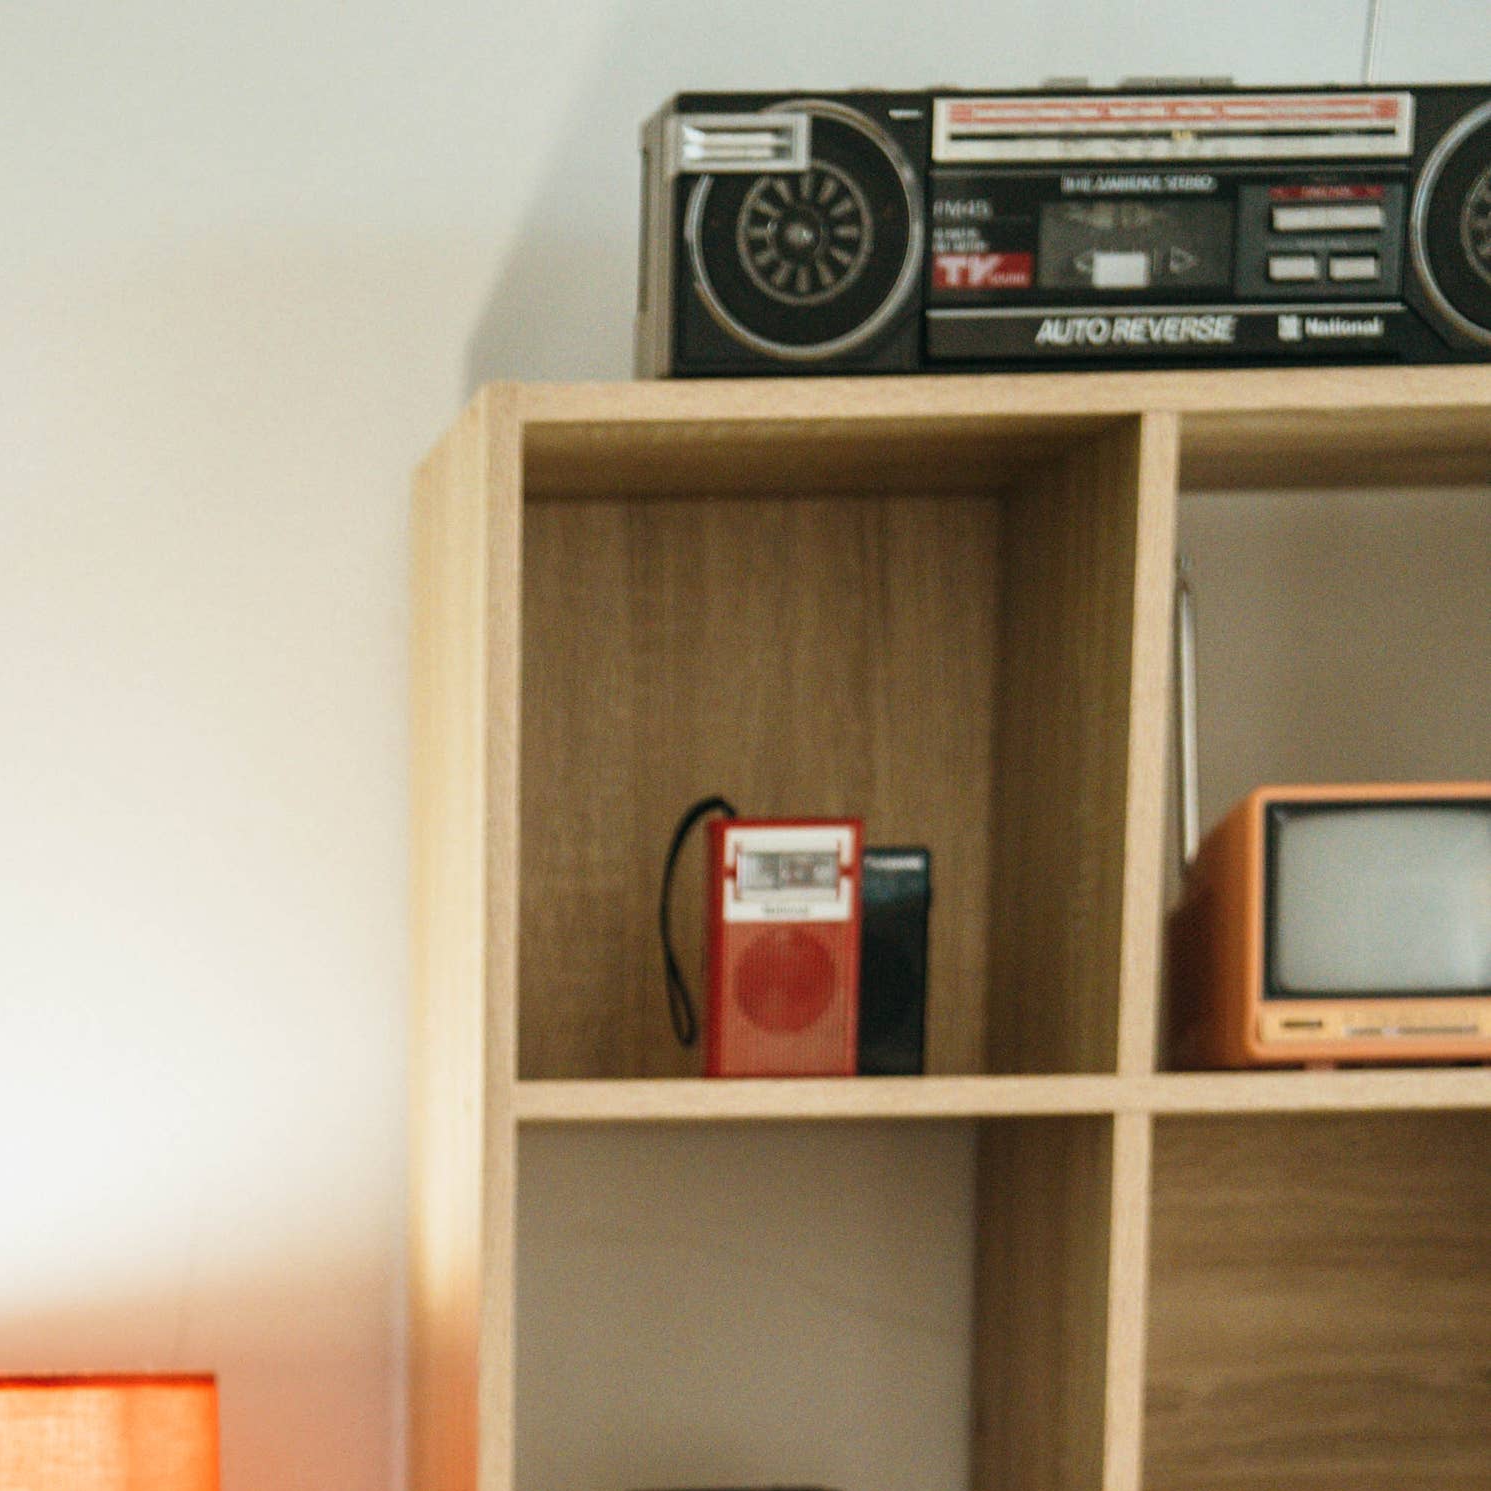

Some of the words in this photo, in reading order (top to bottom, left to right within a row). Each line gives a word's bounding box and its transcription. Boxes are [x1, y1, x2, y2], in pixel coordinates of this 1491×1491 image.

[1035, 316, 1111, 345] AUTO
[1111, 314, 1236, 344] REVERSE
[1305, 316, 1384, 337] National
